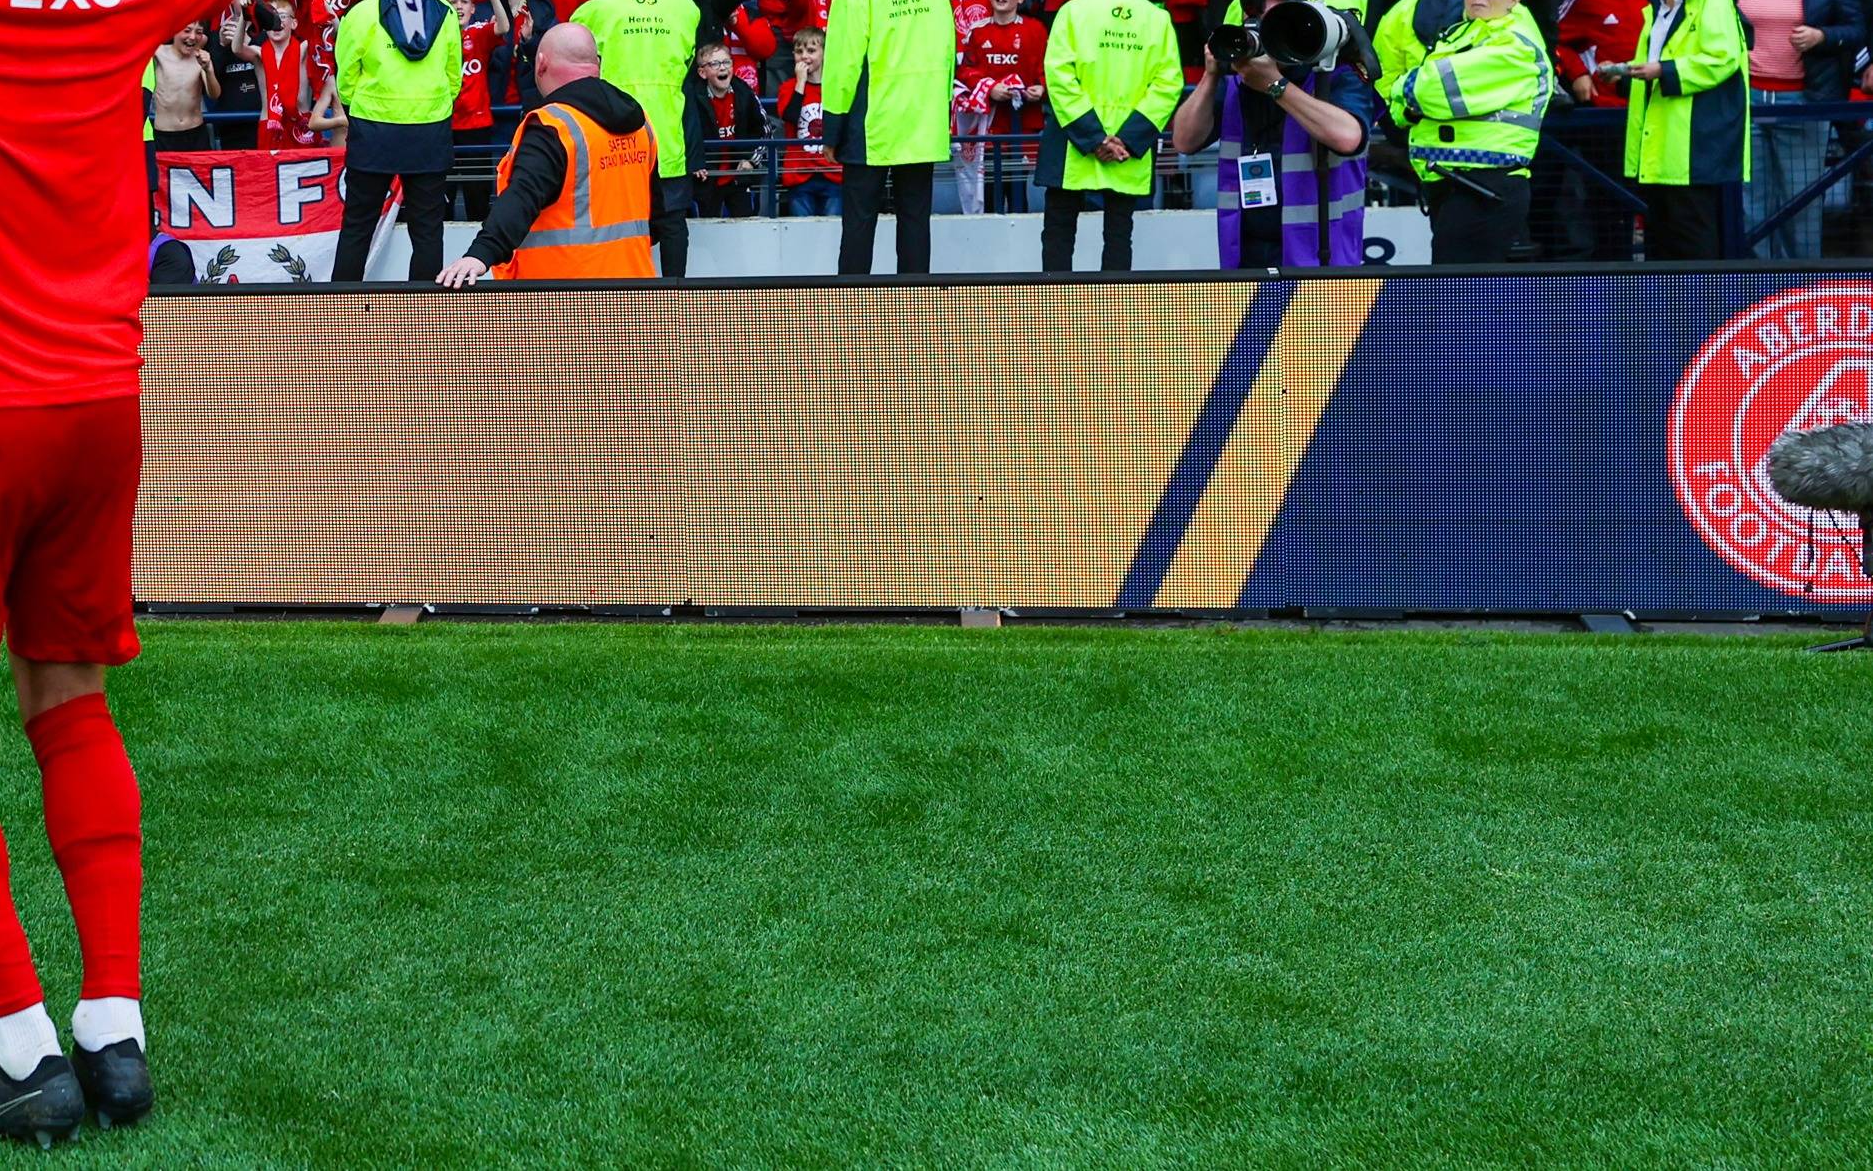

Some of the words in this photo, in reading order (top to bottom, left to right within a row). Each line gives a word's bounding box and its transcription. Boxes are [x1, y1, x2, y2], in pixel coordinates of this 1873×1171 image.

[913, 6, 930, 17] you
[629, 16, 653, 24] Here
[654, 16, 664, 24] to
[624, 26, 654, 35] assist
[655, 26, 671, 35] you
[1127, 29, 1137, 38] to
[1128, 41, 1143, 52] you
[718, 125, 736, 138] EX
[608, 137, 637, 152] SAFETY
